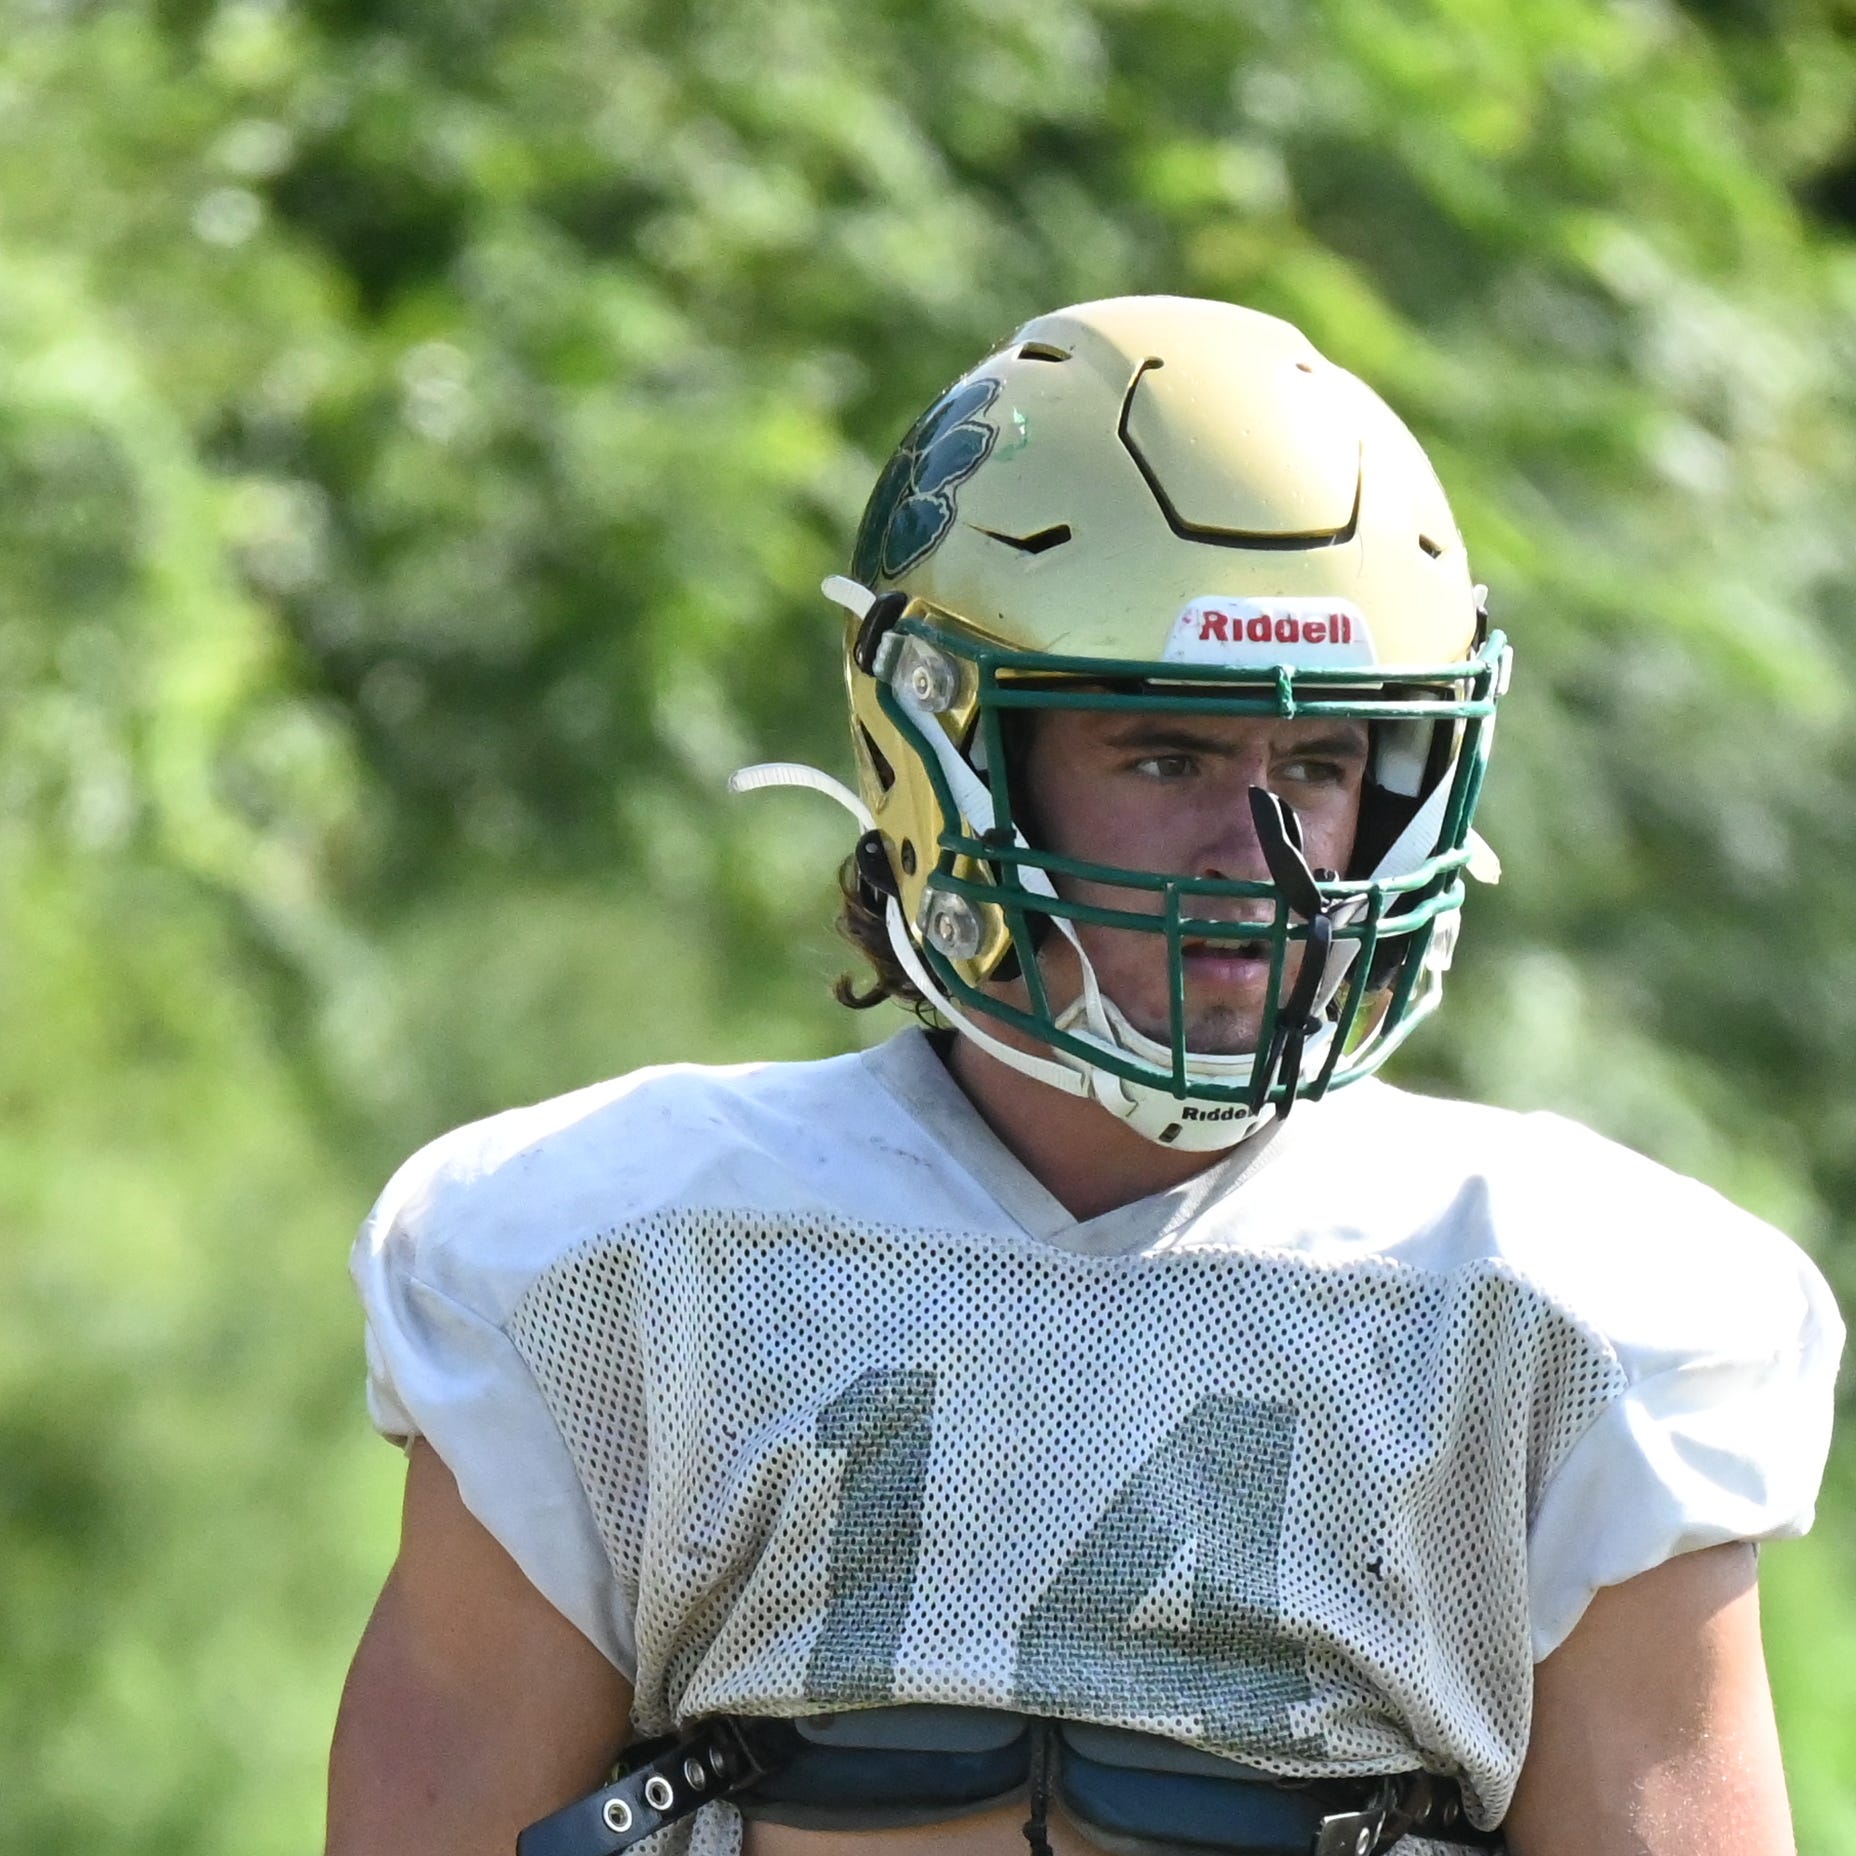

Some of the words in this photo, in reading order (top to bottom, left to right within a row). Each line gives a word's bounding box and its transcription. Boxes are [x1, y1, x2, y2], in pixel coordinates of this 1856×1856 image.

[1199, 610, 1352, 644] Riddell
[1182, 1106, 1250, 1121] Ridde
[804, 1368, 1328, 1758] 14
